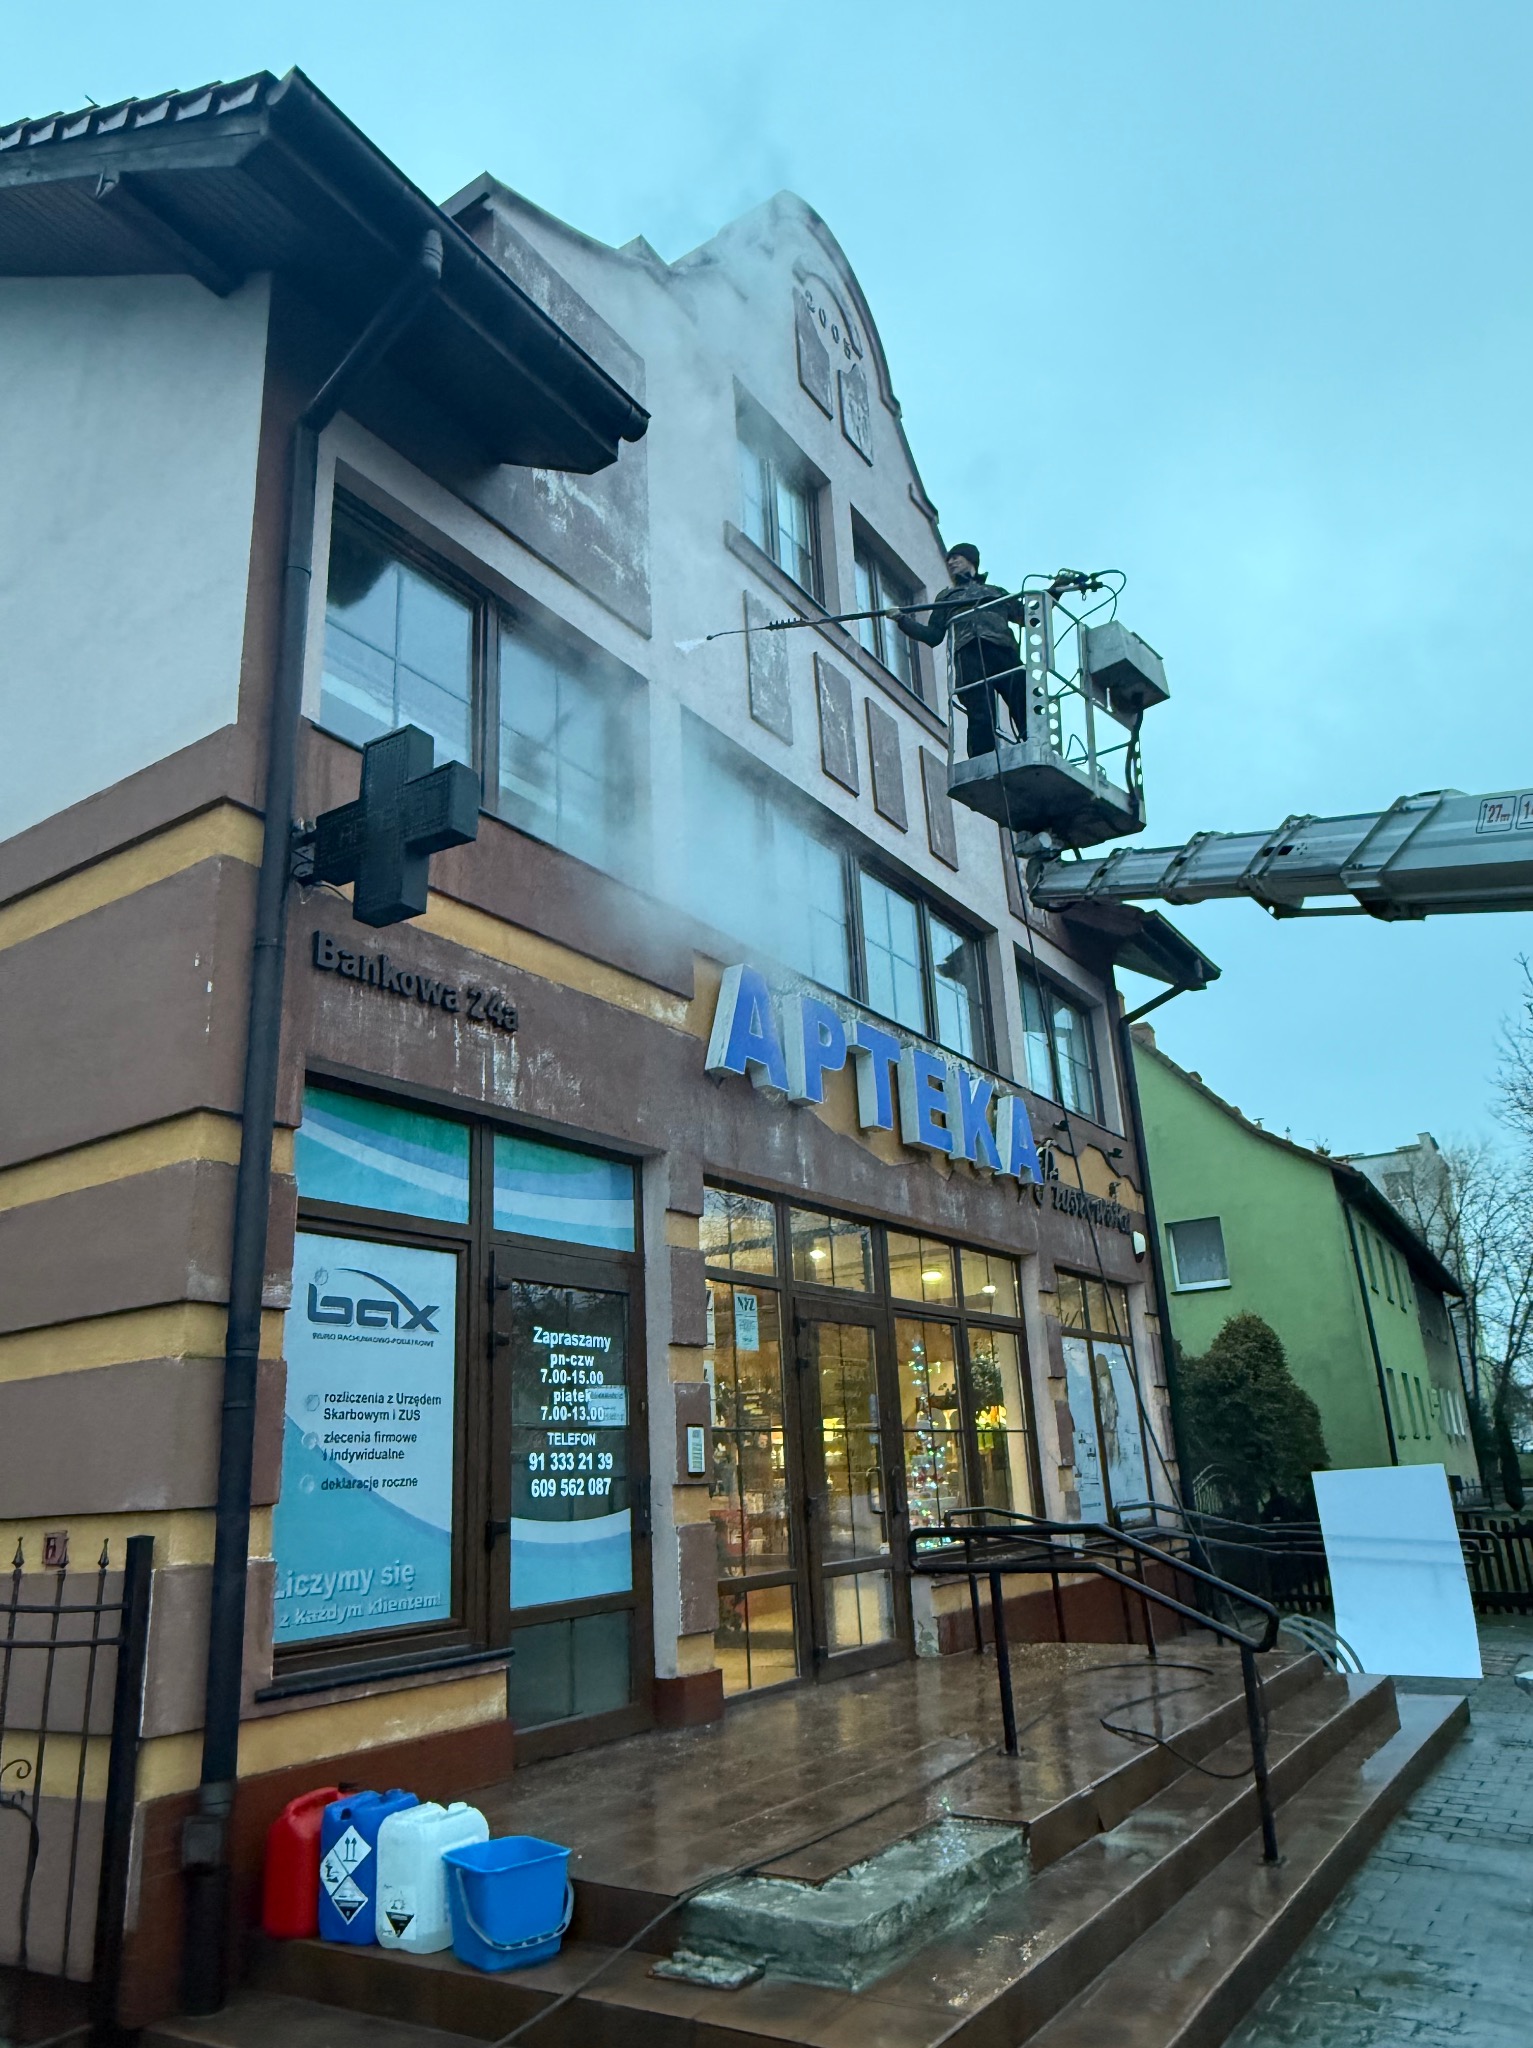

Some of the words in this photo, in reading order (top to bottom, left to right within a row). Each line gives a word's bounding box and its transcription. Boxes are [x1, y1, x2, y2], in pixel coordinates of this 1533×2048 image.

[312, 930, 460, 1013] Bankowa
[467, 985, 519, 1033] 24a
[705, 963, 1045, 1185] APTEKA
[307, 1268, 440, 1333] bax
[532, 1325, 612, 1353] Zapraszamy
[550, 1353, 595, 1369] pn-czw
[540, 1368, 604, 1385] 7.00-15.00
[324, 1391, 385, 1404] rozliczenia
[387, 1394, 394, 1404] z
[396, 1392, 442, 1407] Urzędem
[553, 1388, 593, 1406] piątek
[323, 1407, 390, 1423] Skarbowym
[392, 1409, 396, 1421] i
[398, 1409, 421, 1421] ZUS
[540, 1405, 604, 1421] 7.00-13.00
[323, 1430, 371, 1443] zlecenia
[374, 1430, 418, 1443] firmowe
[546, 1431, 596, 1446] TELEFON
[329, 1448, 405, 1463] indywidualne
[528, 1452, 545, 1471] 91
[550, 1452, 575, 1471] 333
[578, 1452, 593, 1470] 21
[597, 1452, 613, 1470] 39
[320, 1476, 379, 1491] deklaracje
[382, 1477, 419, 1488] roczne
[531, 1478, 556, 1498] 609
[560, 1478, 585, 1497] 562
[588, 1477, 612, 1496] 087
[381, 1560, 416, 1591] się
